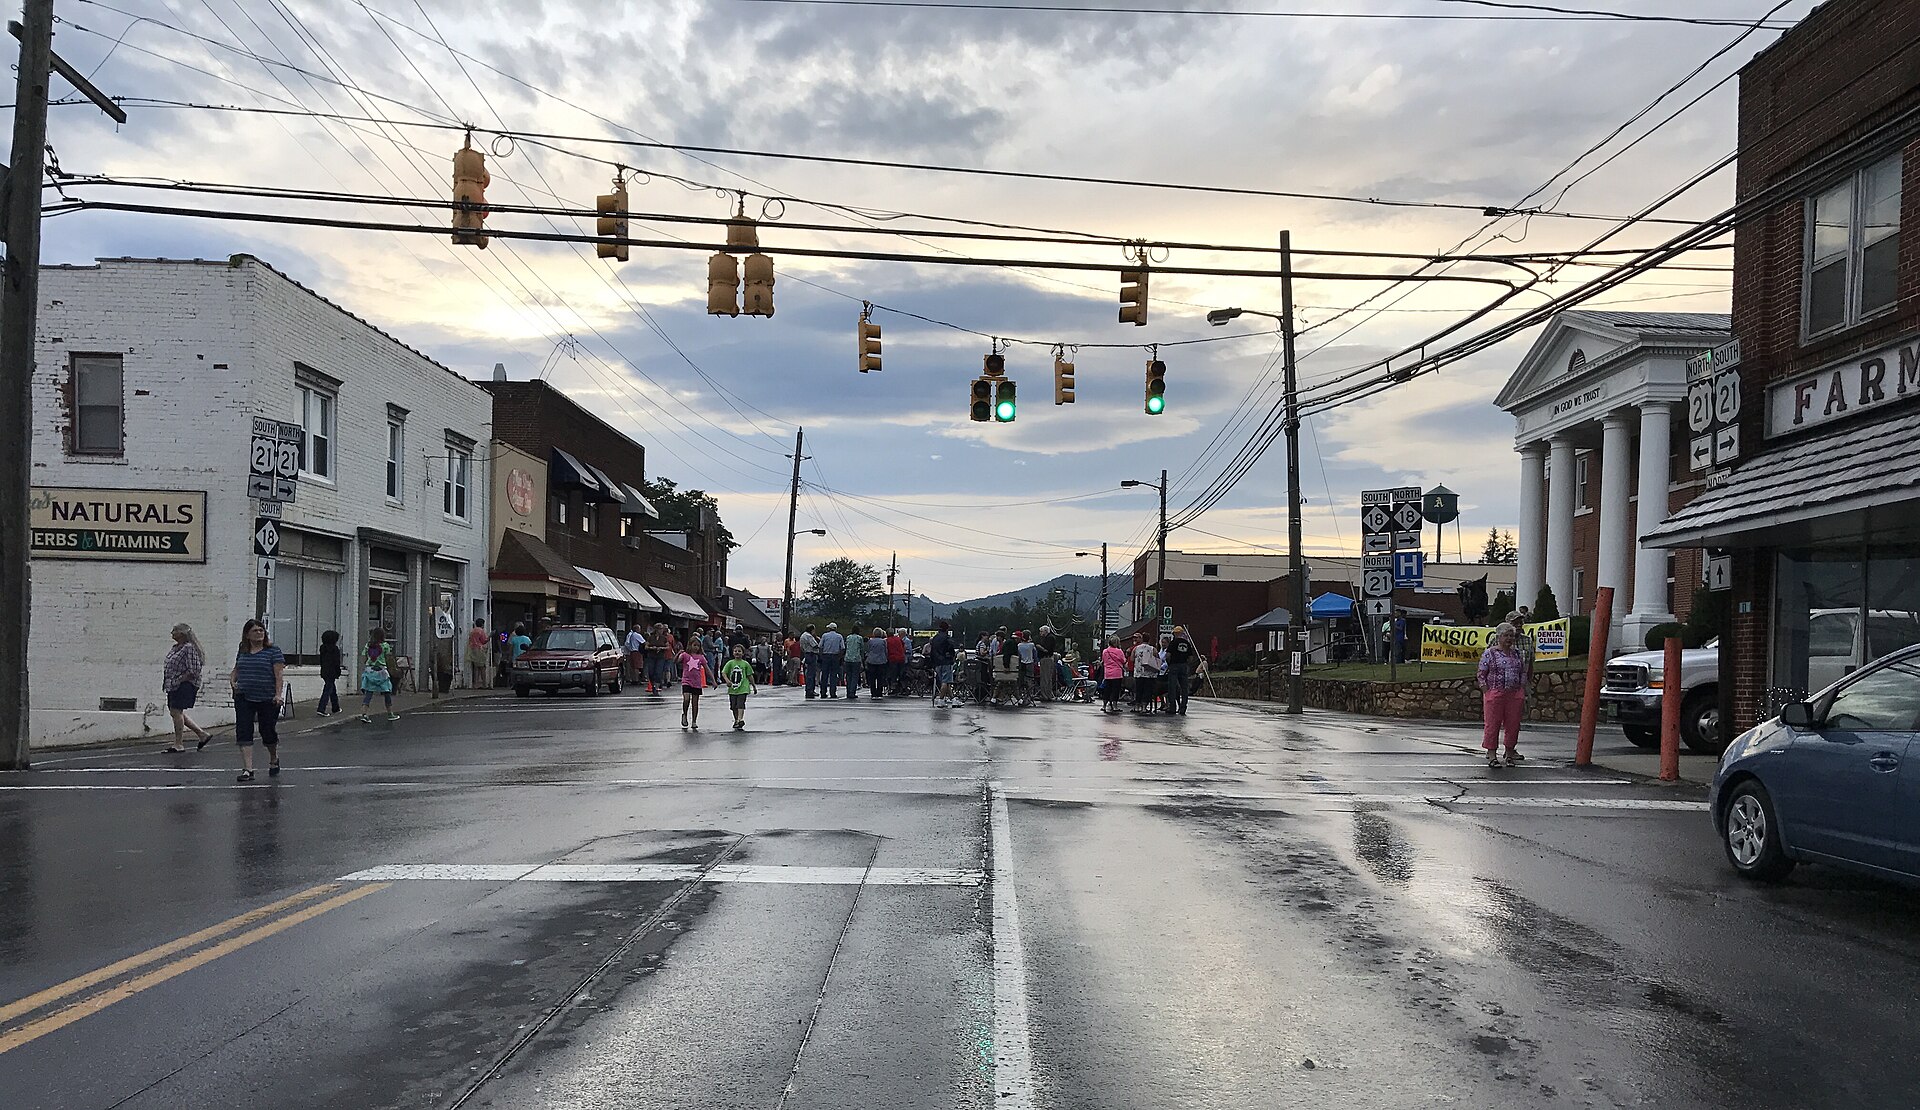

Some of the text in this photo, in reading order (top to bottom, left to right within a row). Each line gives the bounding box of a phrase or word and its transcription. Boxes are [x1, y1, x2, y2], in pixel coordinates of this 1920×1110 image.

[1715, 343, 1739, 367] SOUTH
[1687, 356, 1710, 378] NORTH
[1793, 343, 1920, 425] FARM
[1554, 387, 1600, 415] IN GOD WE TRUST
[1720, 381, 1736, 414] 21
[1693, 392, 1709, 424] 21
[254, 420, 275, 435] SOUTH
[279, 424, 300, 439] NORTH
[256, 446, 271, 467] 21
[281, 450, 295, 471] 21
[1363, 493, 1388, 502] SOUTH
[1395, 490, 1420, 499] NORTH
[52, 501, 193, 524] NATURALS
[261, 502, 280, 515] SOUTH
[1400, 510, 1415, 523] 18
[1369, 513, 1383, 527] 18
[95, 532, 171, 549] VITAMINS
[262, 529, 275, 546] 18
[1366, 557, 1391, 566] NORTH
[1400, 554, 1418, 576] H
[1370, 576, 1388, 591] 21
[1423, 628, 1478, 646] MUSIC
